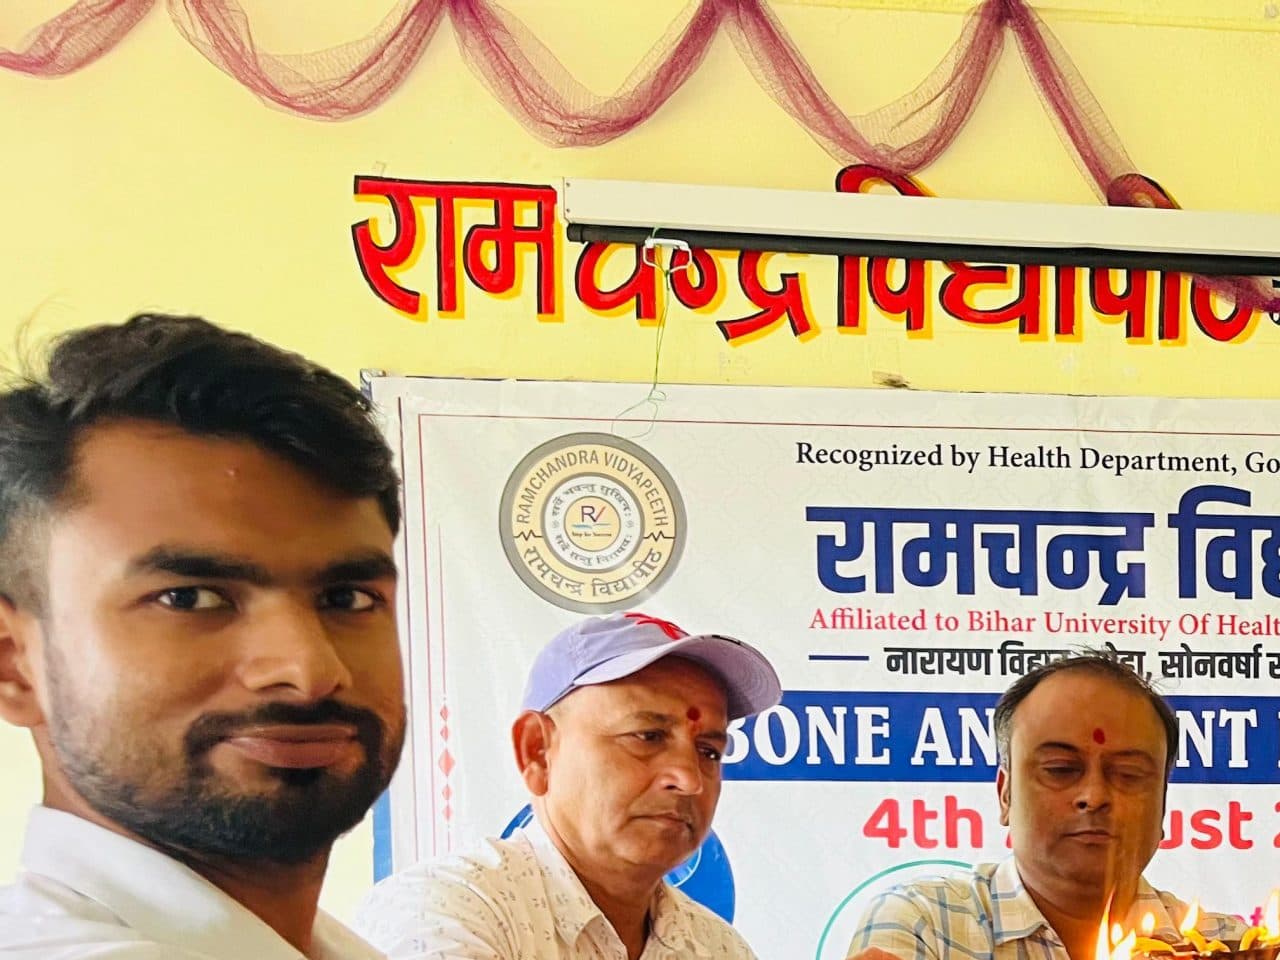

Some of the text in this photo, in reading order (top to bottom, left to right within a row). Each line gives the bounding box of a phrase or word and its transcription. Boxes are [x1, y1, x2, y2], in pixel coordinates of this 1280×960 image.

[795, 442, 943, 469] Recognized
[951, 444, 980, 474] by
[988, 445, 1071, 468] Health
[1080, 447, 1237, 476] Department,
[516, 449, 669, 527] RAMCHANDRA VIDYAPEETH
[524, 546, 662, 597] रामचन्द्र विद्यापीठ
[806, 506, 1155, 605] रामचन्द्र
[808, 607, 928, 631] Affiliated
[935, 611, 960, 632] to
[967, 610, 1037, 633] Bihar
[1045, 611, 1171, 641] University
[1179, 613, 1211, 636] Of
[884, 647, 994, 676] नारायण
[1158, 643, 1263, 680] सोनवर्षा
[863, 794, 984, 849] 4th
